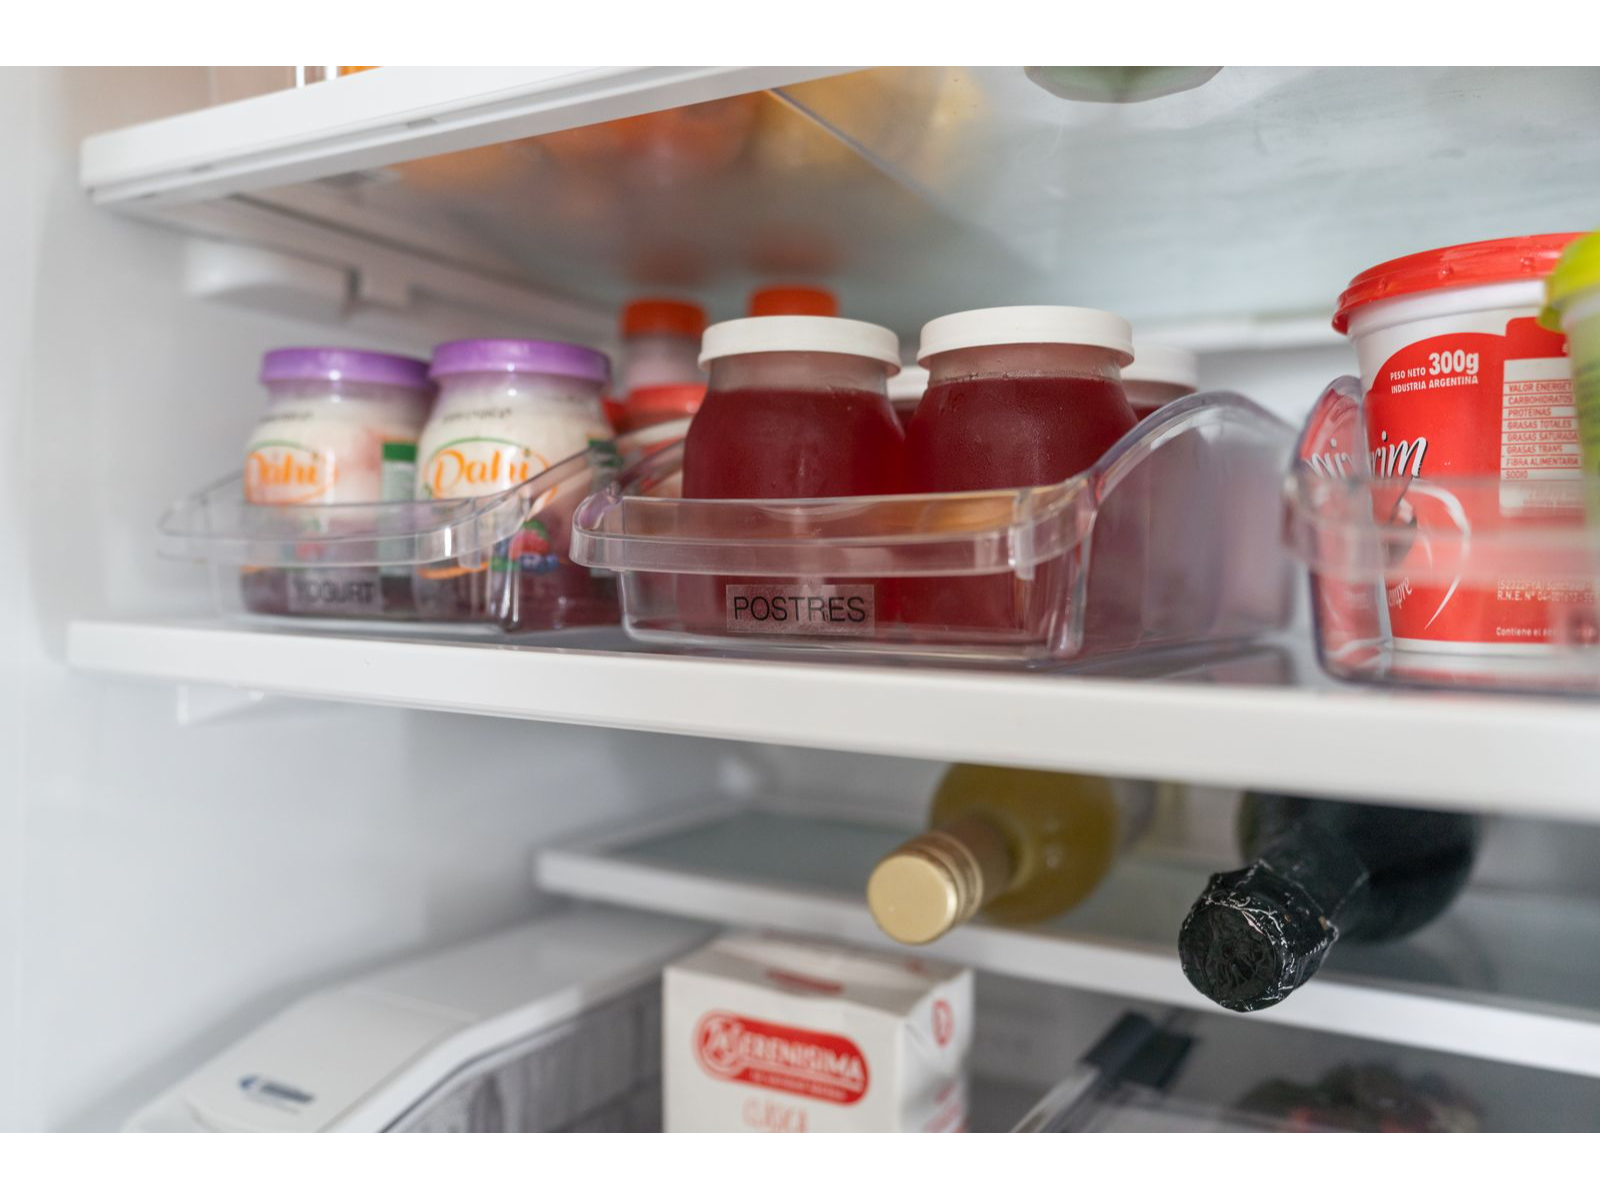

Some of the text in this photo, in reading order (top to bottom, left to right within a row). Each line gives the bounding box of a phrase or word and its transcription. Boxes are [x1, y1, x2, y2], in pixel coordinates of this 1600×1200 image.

[1390, 349, 1479, 381] PESO NETO 300g
[1391, 374, 1479, 394] INDUSTRIA ARGENTINA
[1508, 383, 1534, 393] VALOR
[1508, 394, 1573, 405] CARBOHIDRATOS
[1508, 407, 1552, 418] PROTEINAS
[1507, 419, 1572, 430] GRASAS TOTALES
[1507, 432, 1537, 442] GRASAS
[1506, 444, 1563, 454] GRASAS TRANS
[1506, 456, 1579, 467] FIBRA ALIMENTARIA
[1505, 470, 1529, 480] SODIO
[293, 579, 375, 604] YOGURT
[733, 595, 867, 623] POSTRES
[1496, 627, 1532, 637] Contiene
